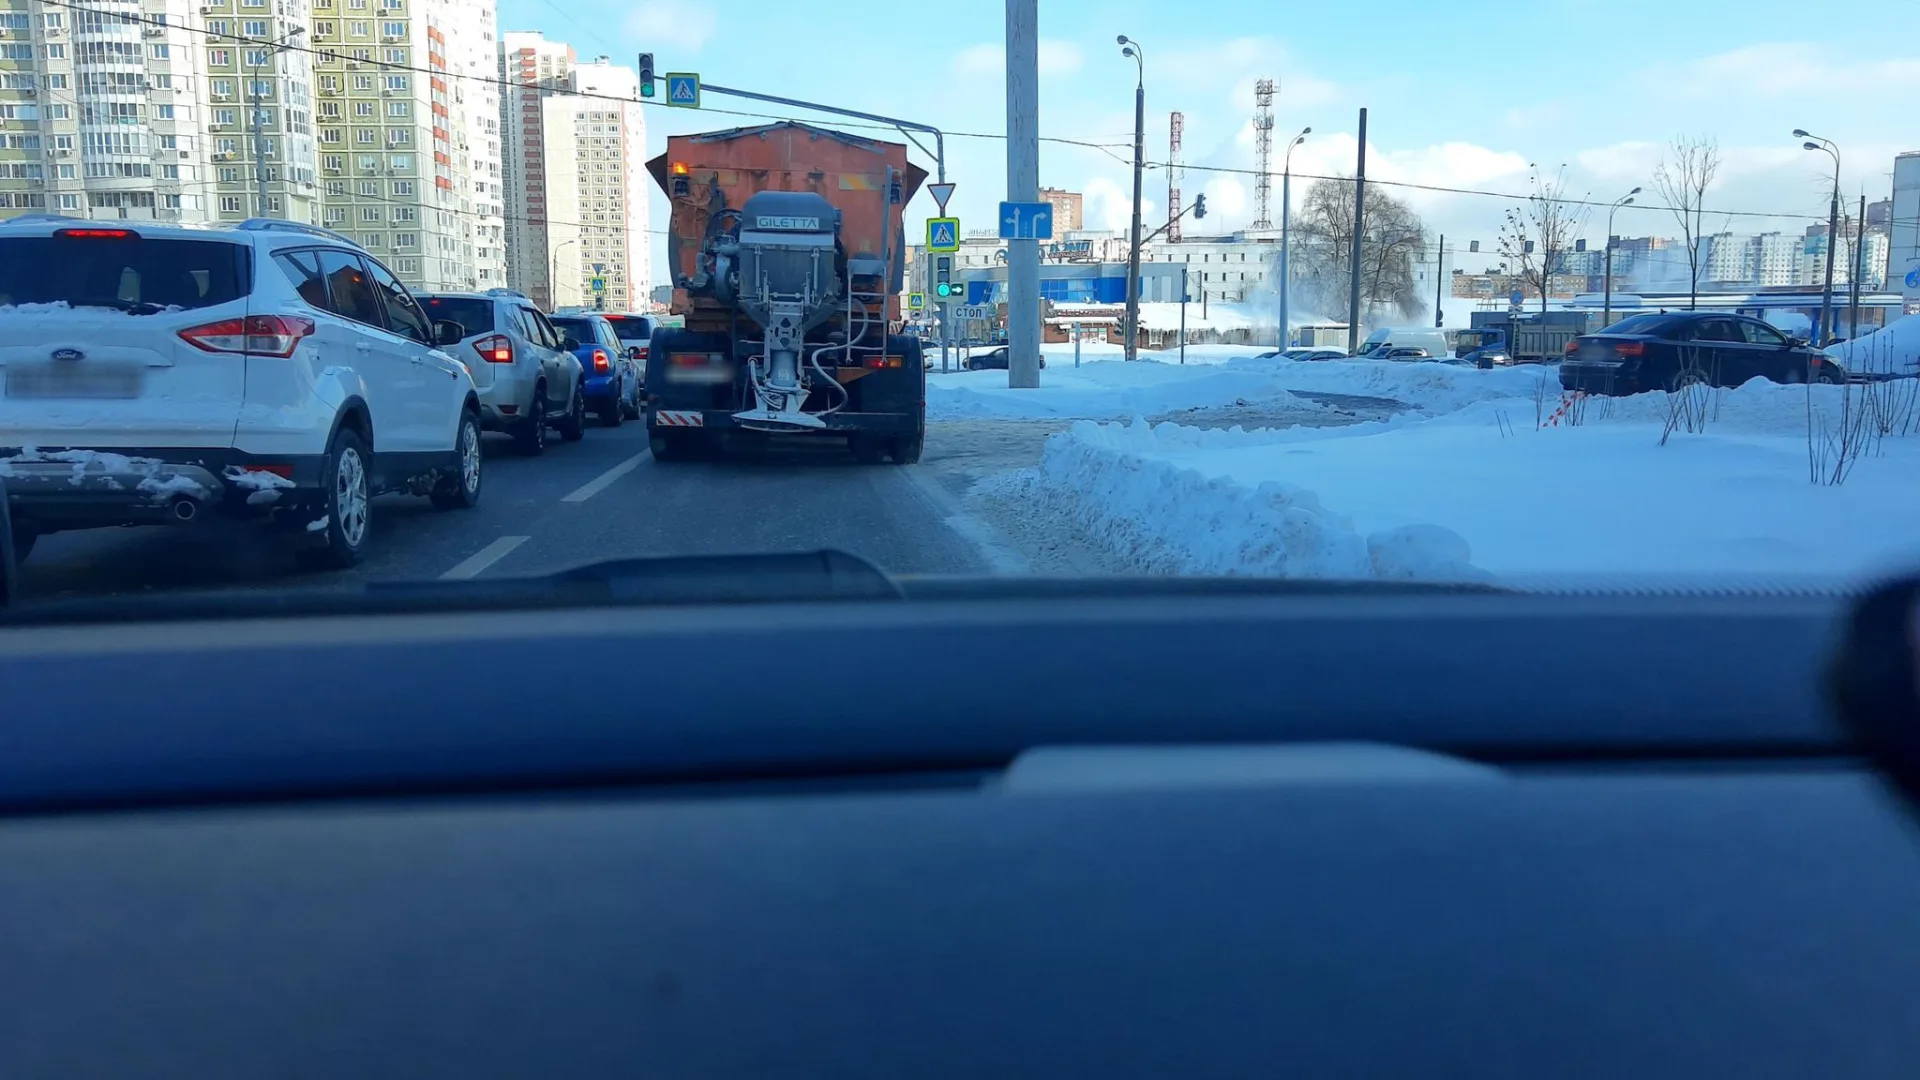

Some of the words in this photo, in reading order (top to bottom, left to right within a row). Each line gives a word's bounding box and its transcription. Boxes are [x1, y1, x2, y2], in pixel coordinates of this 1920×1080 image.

[758, 217, 817, 229] GILETTA
[956, 307, 982, 318] СТОП
[57, 350, 76, 359] Ford
